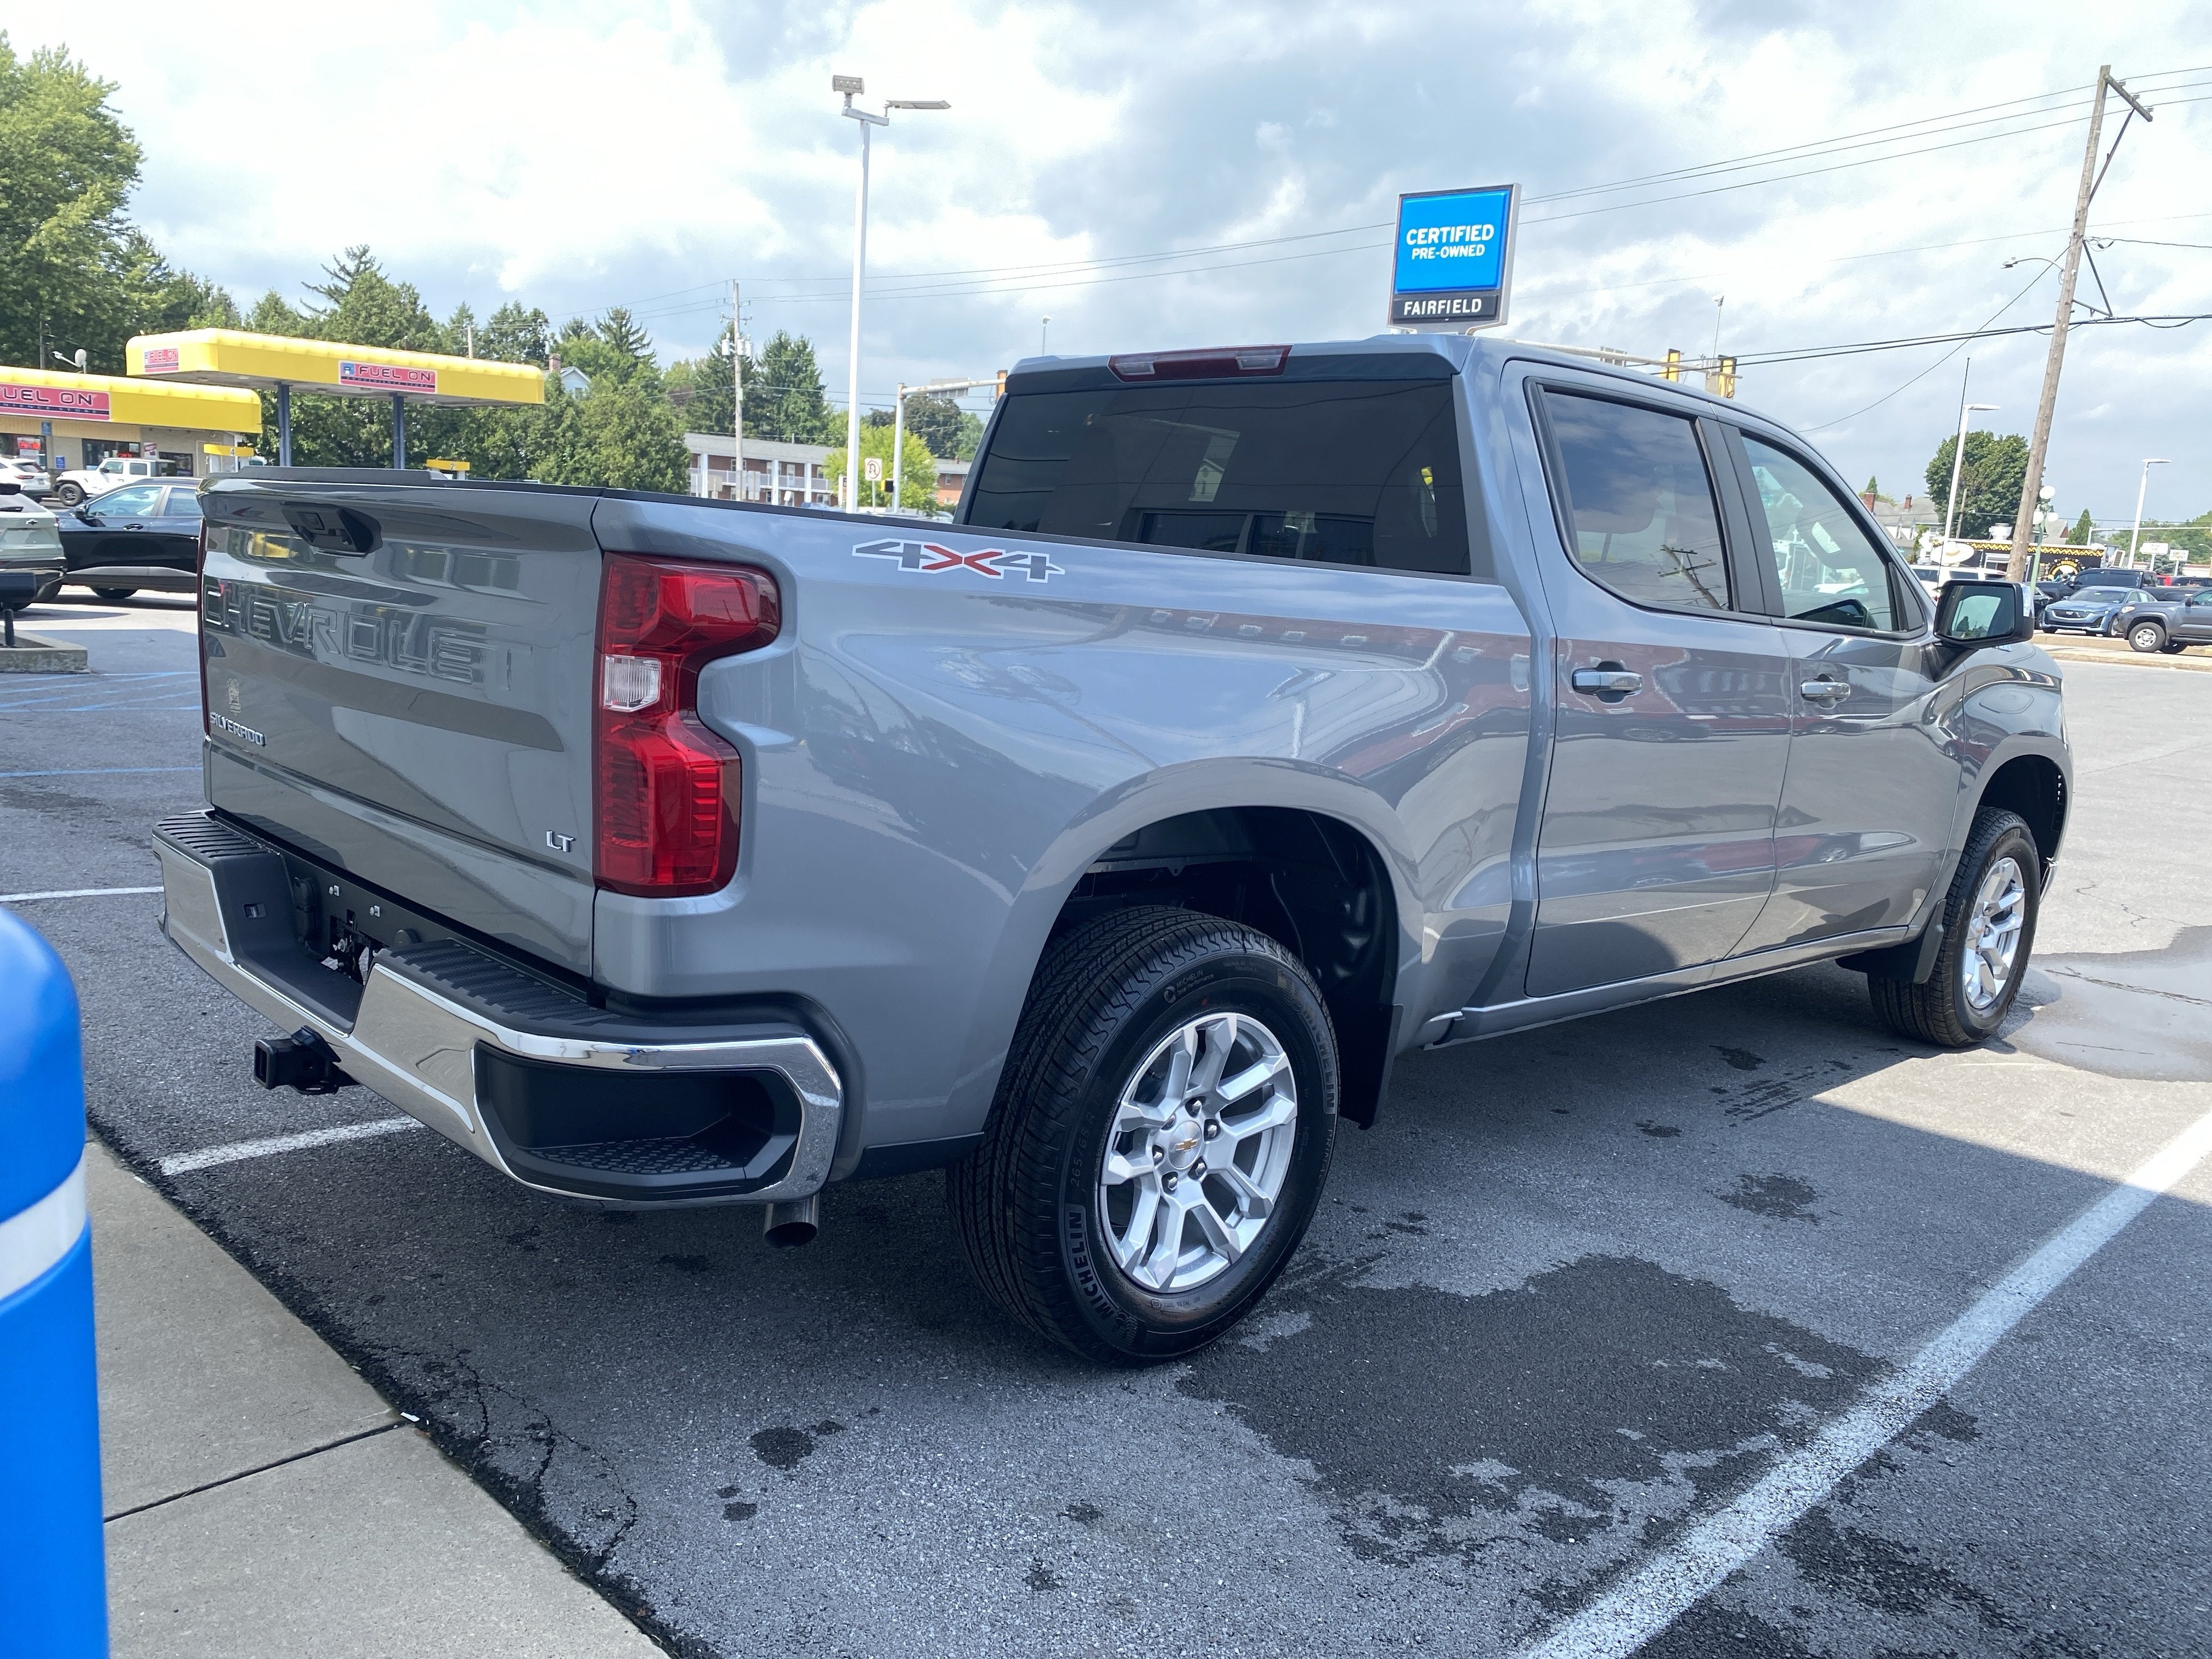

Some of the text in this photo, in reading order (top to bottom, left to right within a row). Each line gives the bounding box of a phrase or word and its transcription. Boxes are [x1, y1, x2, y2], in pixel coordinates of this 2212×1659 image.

[1406, 224, 1494, 245] CERTIFIED
[1412, 244, 1486, 260] PRE-OWNED
[1403, 298, 1482, 316] FAIRFIELD
[150, 352, 166, 361] FUEL
[359, 366, 430, 381] FUEL ON
[0, 387, 92, 405] UEL ON
[201, 584, 533, 691] CHEVROLET
[210, 712, 264, 746] SILVERADO
[546, 831, 575, 852] LT
[1176, 970, 1204, 989] MICHELIN
[1302, 1005, 1335, 1108] MICHELIN
[1070, 1127, 1089, 1188] 265/65
[1069, 1211, 1115, 1321] MICHELIN
